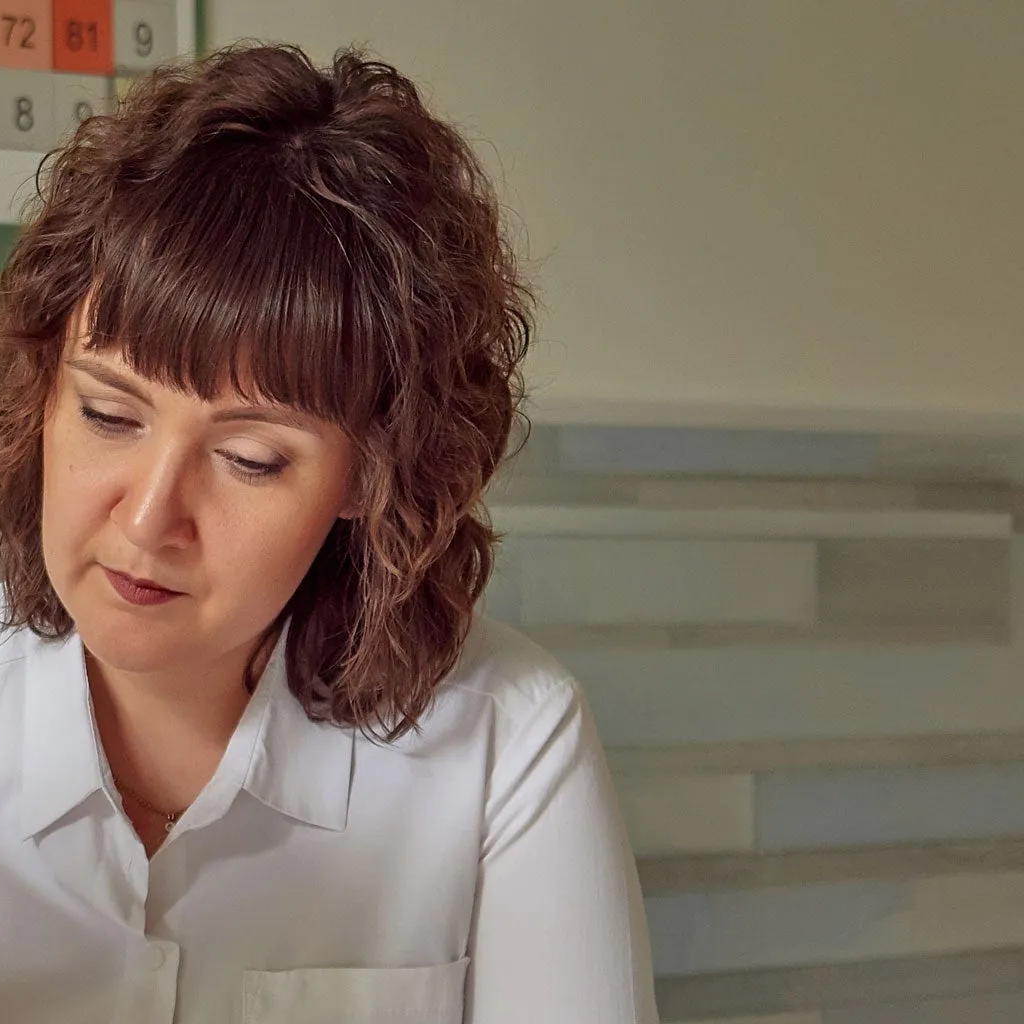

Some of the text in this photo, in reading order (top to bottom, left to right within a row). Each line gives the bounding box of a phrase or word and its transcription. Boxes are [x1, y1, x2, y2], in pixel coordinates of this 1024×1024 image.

[0, 15, 36, 49] 72
[66, 19, 98, 51] 81
[135, 22, 153, 57] 9
[15, 96, 34, 132] 8
